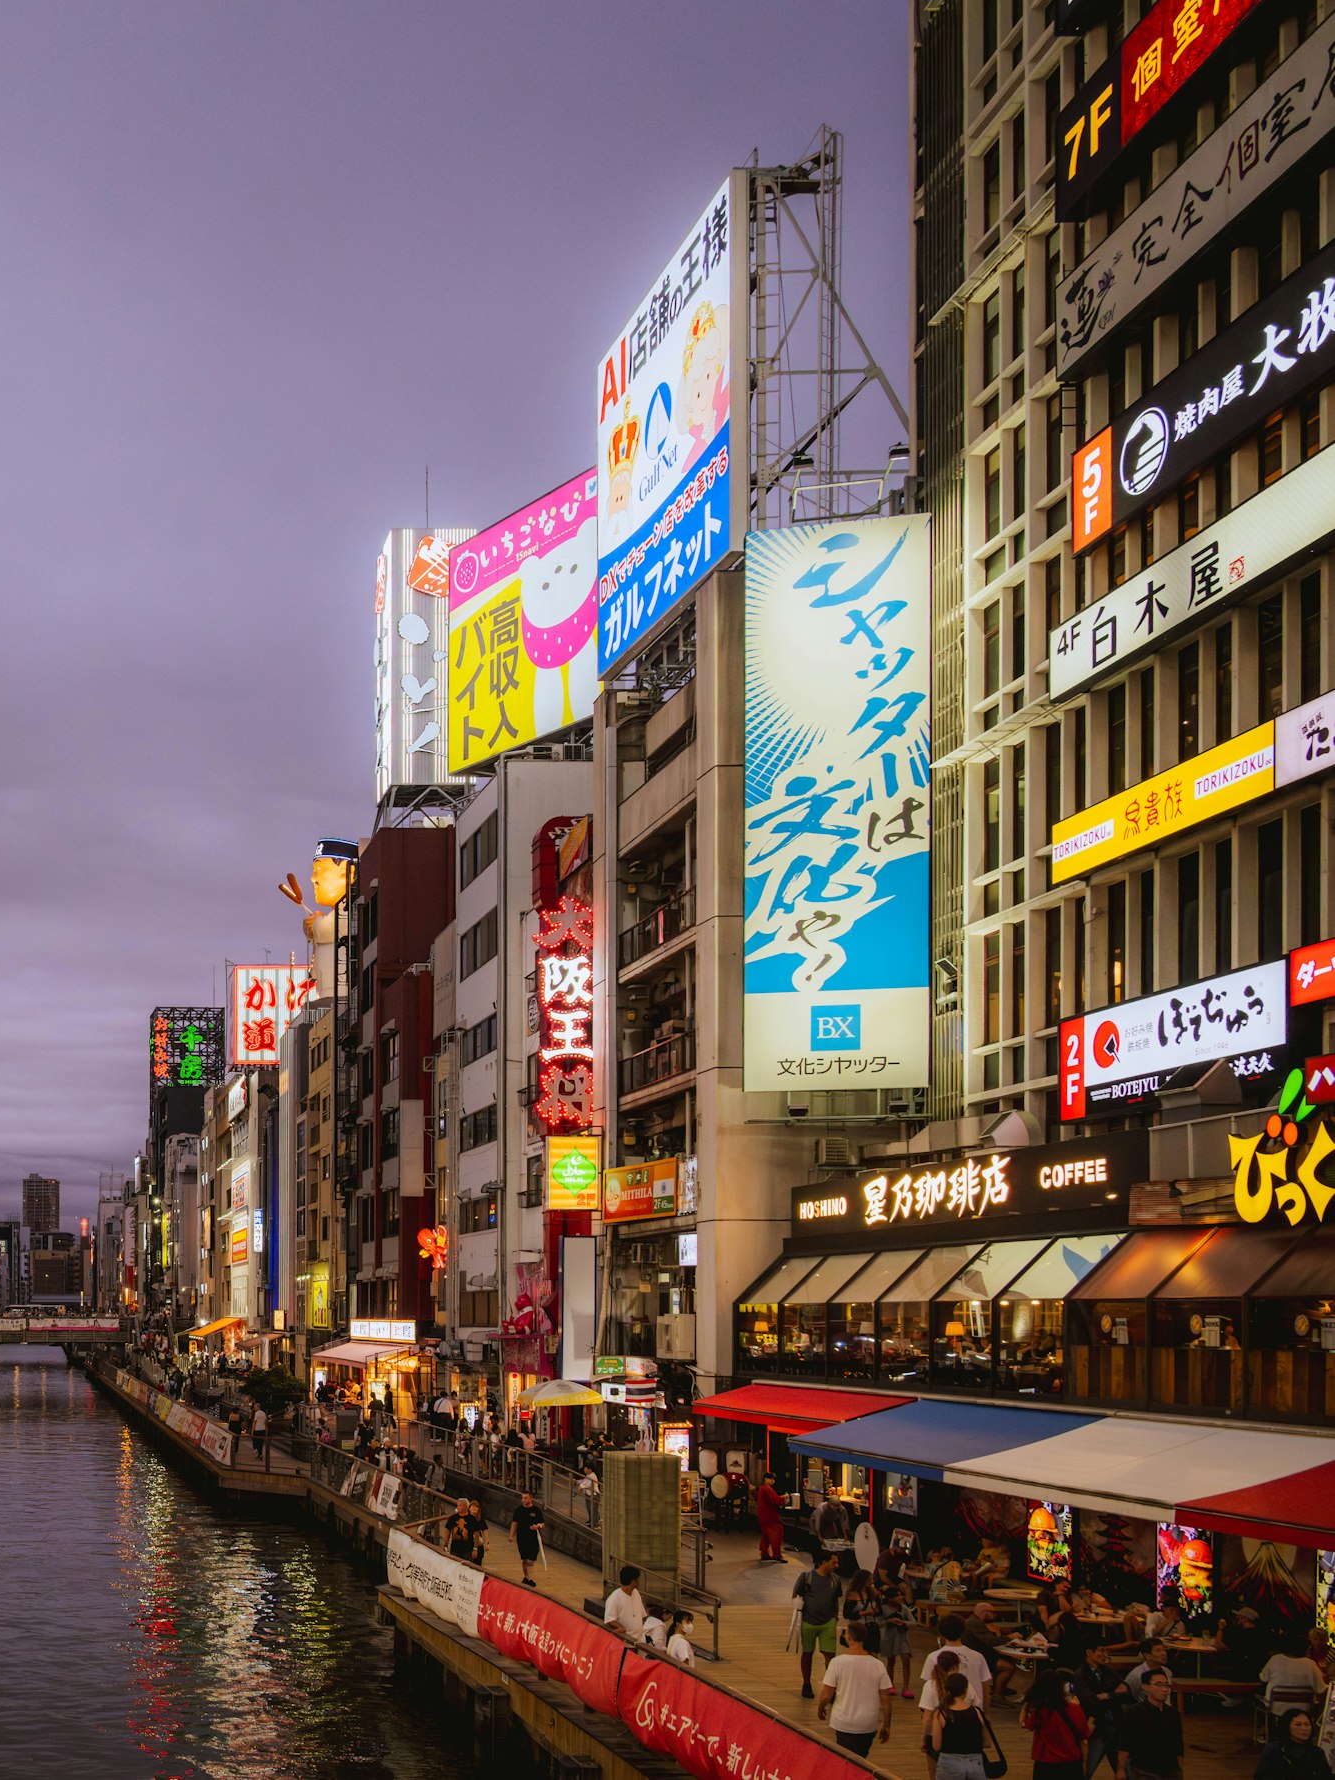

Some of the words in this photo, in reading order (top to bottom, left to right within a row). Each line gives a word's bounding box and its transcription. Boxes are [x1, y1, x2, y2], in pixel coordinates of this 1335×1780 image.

[1131, 0, 1221, 103] 個室
[1064, 83, 1113, 182] 7F
[600, 194, 729, 425] AI店舗の王様
[1173, 364, 1245, 443] 焼肉屋
[600, 445, 729, 606] DXでチェーン店を改革する
[1081, 446, 1103, 536] 5F
[603, 501, 723, 660] ガルフネット
[1056, 620, 1083, 656] 4F
[1091, 540, 1224, 669] 白木屋
[454, 610, 488, 762] バイト
[488, 596, 521, 751] 高収入
[1196, 752, 1265, 796] TORIKIZOKU
[1305, 726, 1335, 761] た
[1053, 824, 1107, 860] TORIKIZOKU
[1296, 956, 1335, 989] ダー
[532, 895, 594, 1128] 大阪王将
[816, 1015, 856, 1040] BX
[1066, 1033, 1081, 1106] 2F
[1111, 1074, 1160, 1098] BOTEJYU
[576, 1192, 597, 1207] 2F
[620, 1186, 654, 1202] MITHILA
[799, 1195, 848, 1221] HOSHINO
[863, 1153, 1012, 1227] 星乃珈琲店
[1039, 1158, 1109, 1190] COFFEE
